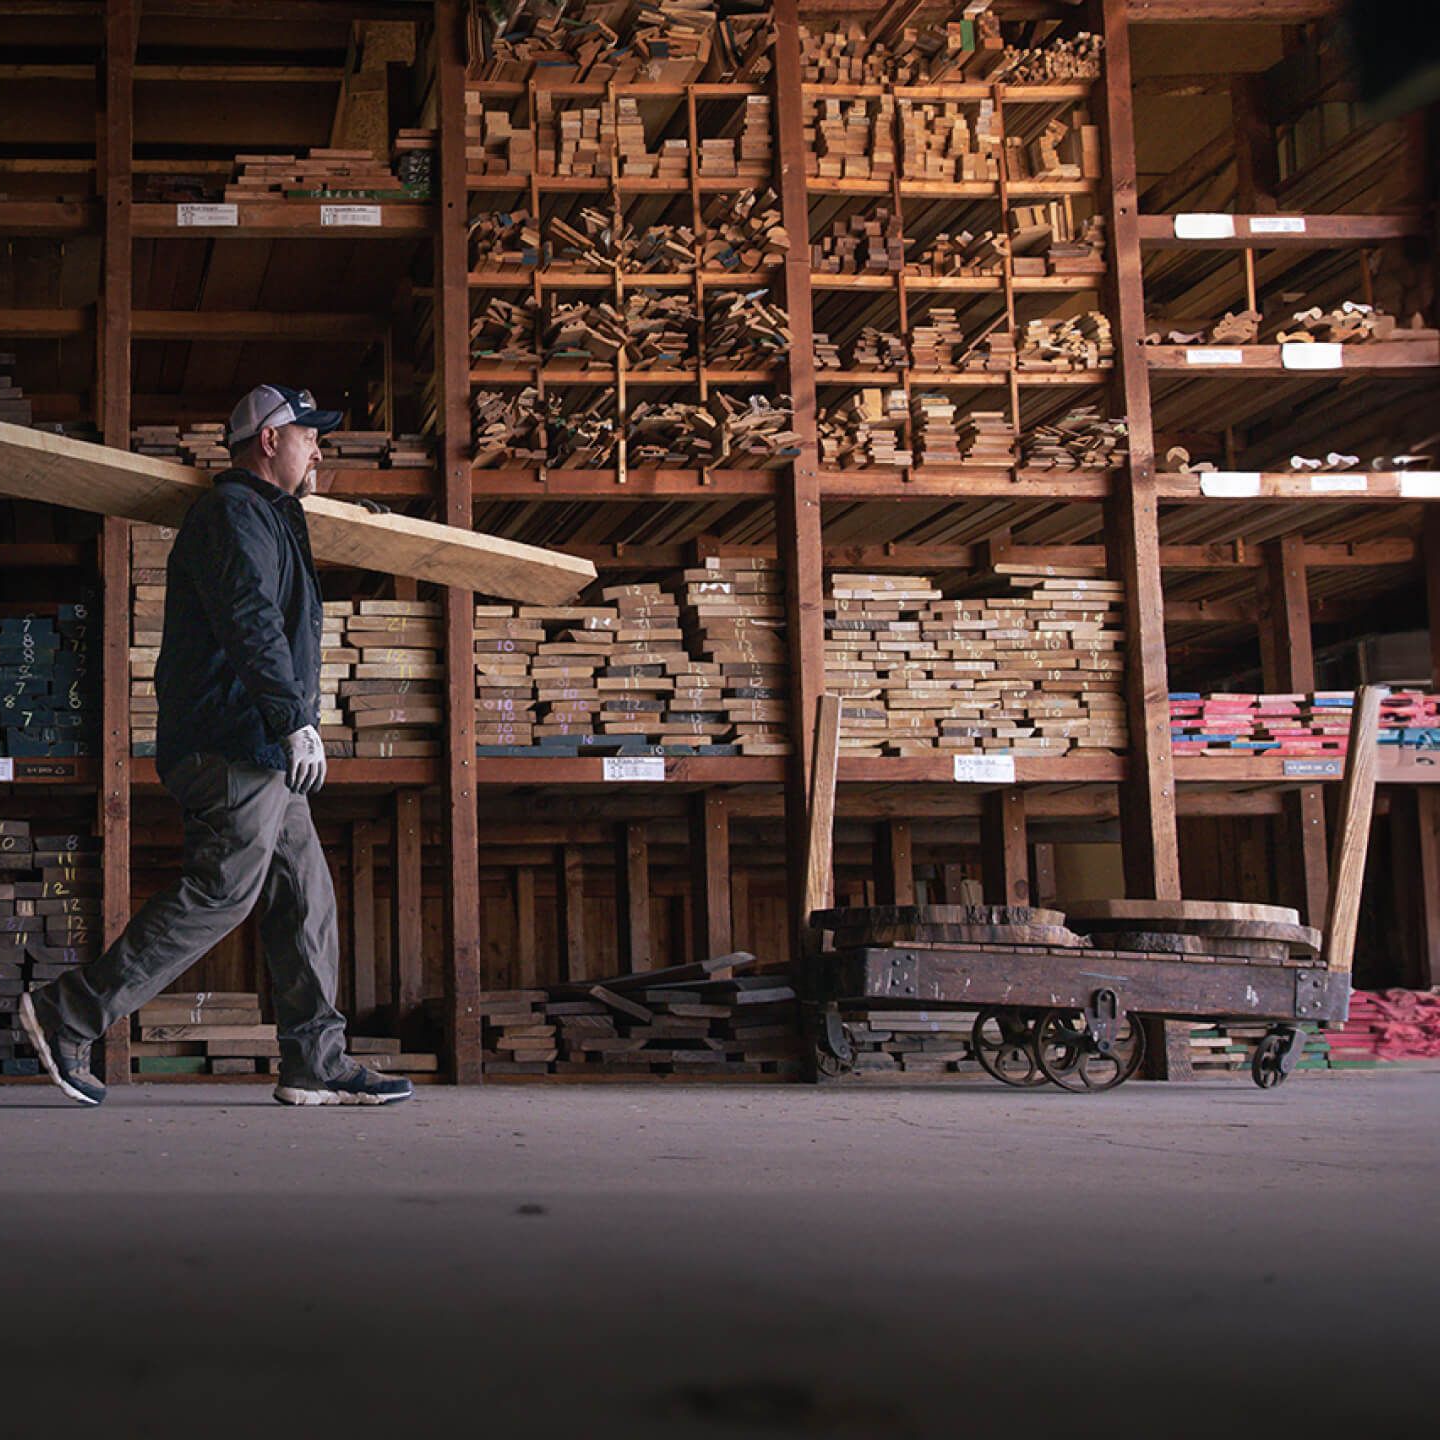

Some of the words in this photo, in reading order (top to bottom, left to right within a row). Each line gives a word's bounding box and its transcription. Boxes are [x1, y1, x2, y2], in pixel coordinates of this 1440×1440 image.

[497, 640, 515, 652] 10
[14, 682, 26, 696] 7
[21, 711, 33, 728] 7
[42, 881, 71, 898] 12
